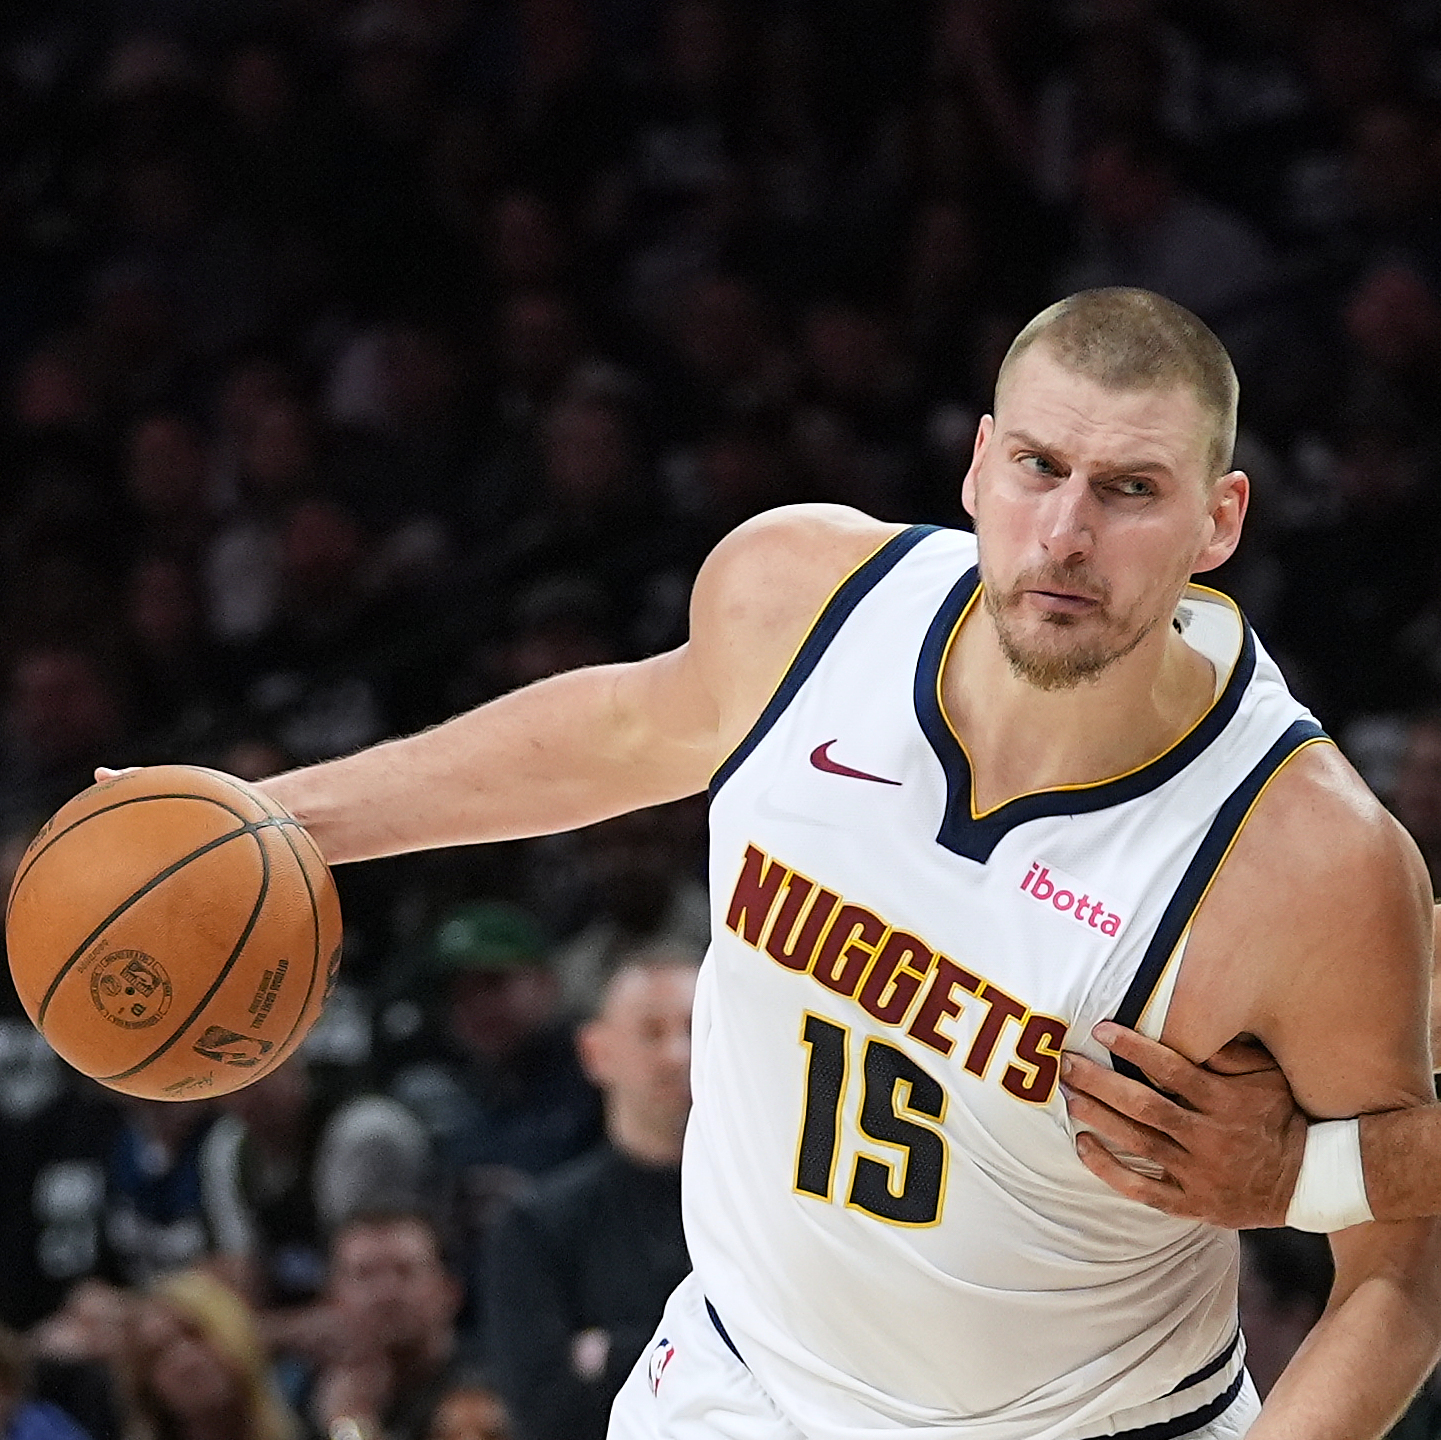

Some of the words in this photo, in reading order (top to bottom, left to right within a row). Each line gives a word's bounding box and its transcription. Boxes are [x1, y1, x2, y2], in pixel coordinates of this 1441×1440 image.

[725, 840, 1071, 1108] NUGGETS
[1020, 861, 1121, 937] ibotta
[792, 1009, 949, 1228] 15
